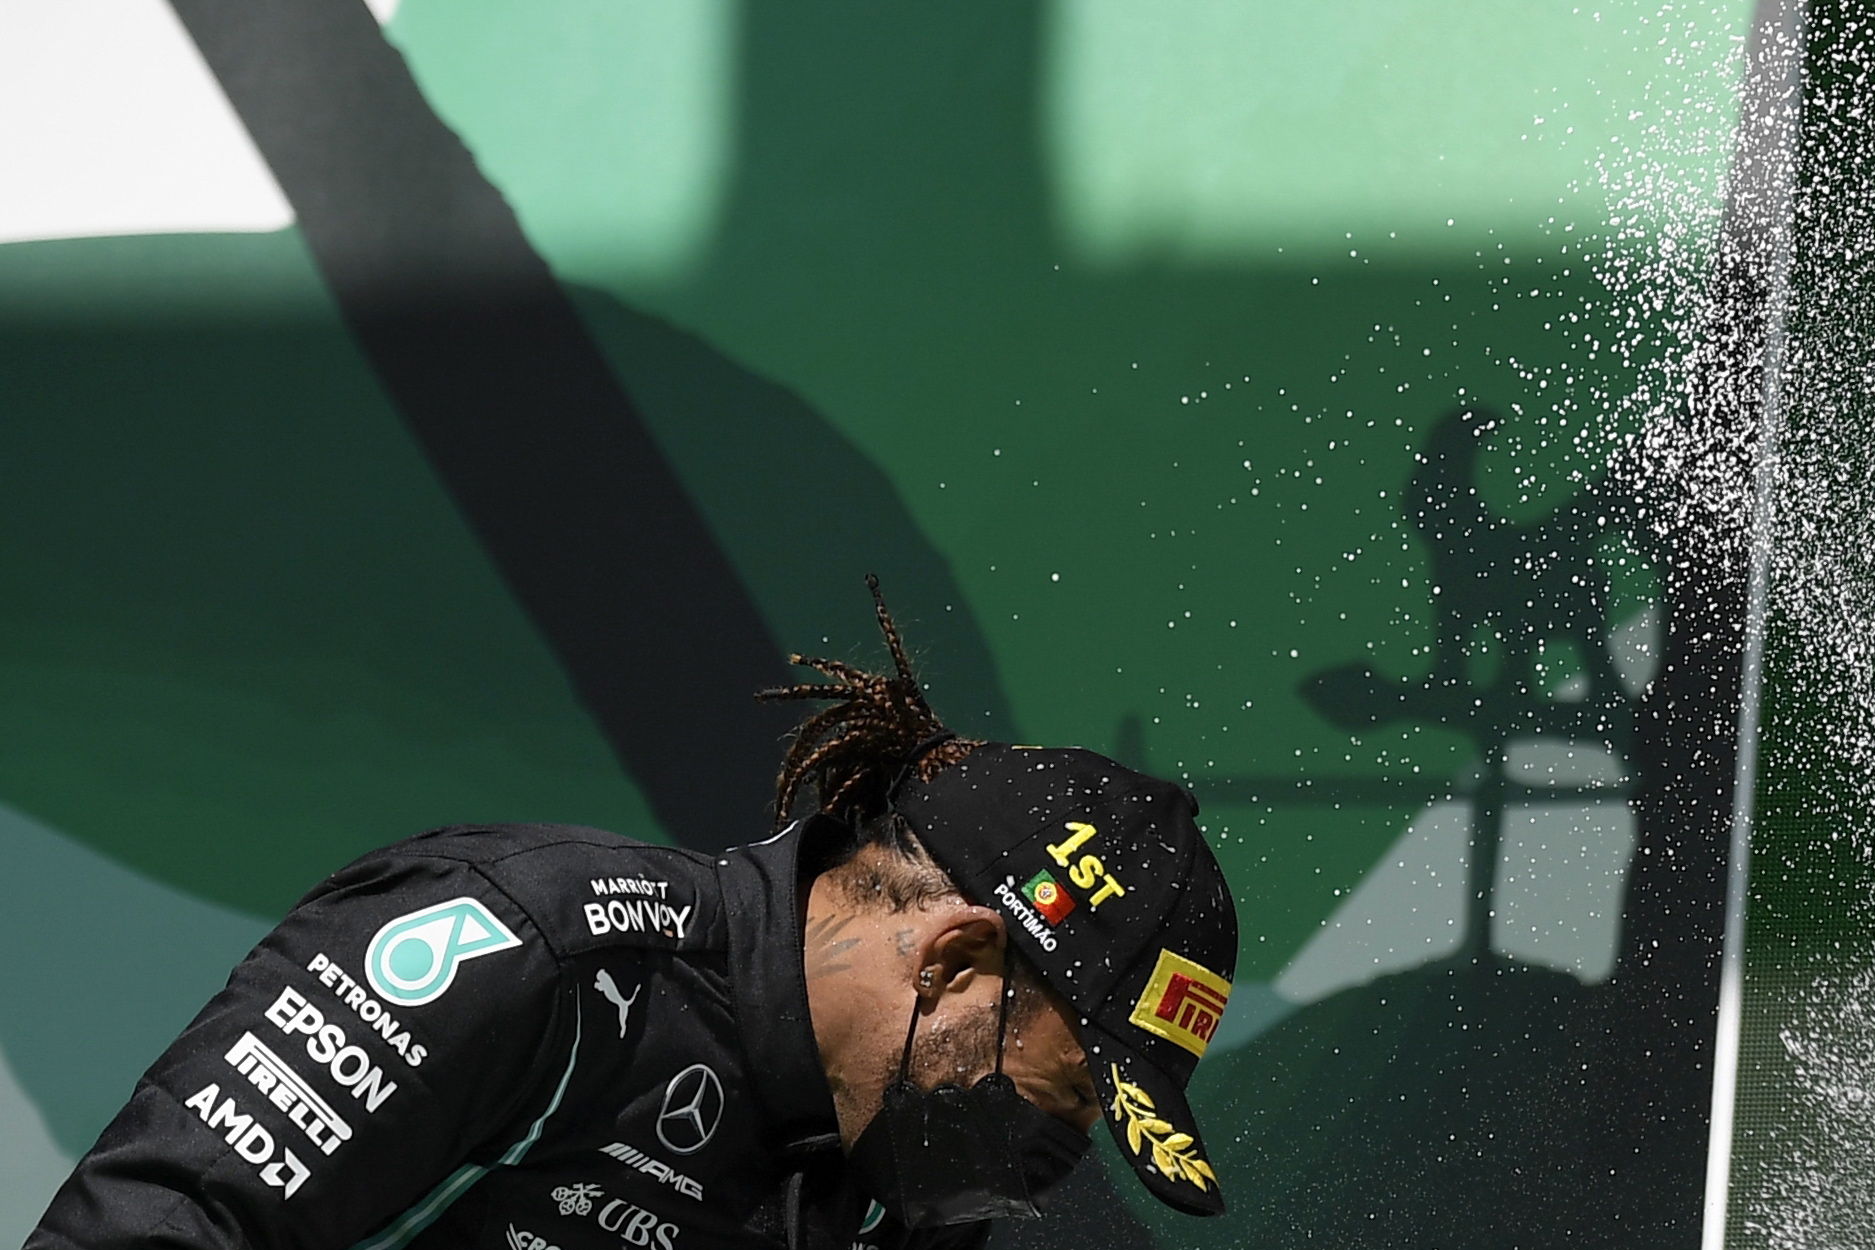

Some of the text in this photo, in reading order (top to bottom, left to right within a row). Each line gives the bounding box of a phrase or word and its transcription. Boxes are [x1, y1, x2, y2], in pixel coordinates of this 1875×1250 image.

[1045, 820, 1126, 908] 1ST
[583, 899, 692, 939] BONVOY
[264, 984, 398, 1115] EPSON
[307, 951, 429, 1069] PETRONAS
[184, 1082, 276, 1166] AMD
[223, 1030, 354, 1157] PIRELLI
[637, 1158, 704, 1202] AMG
